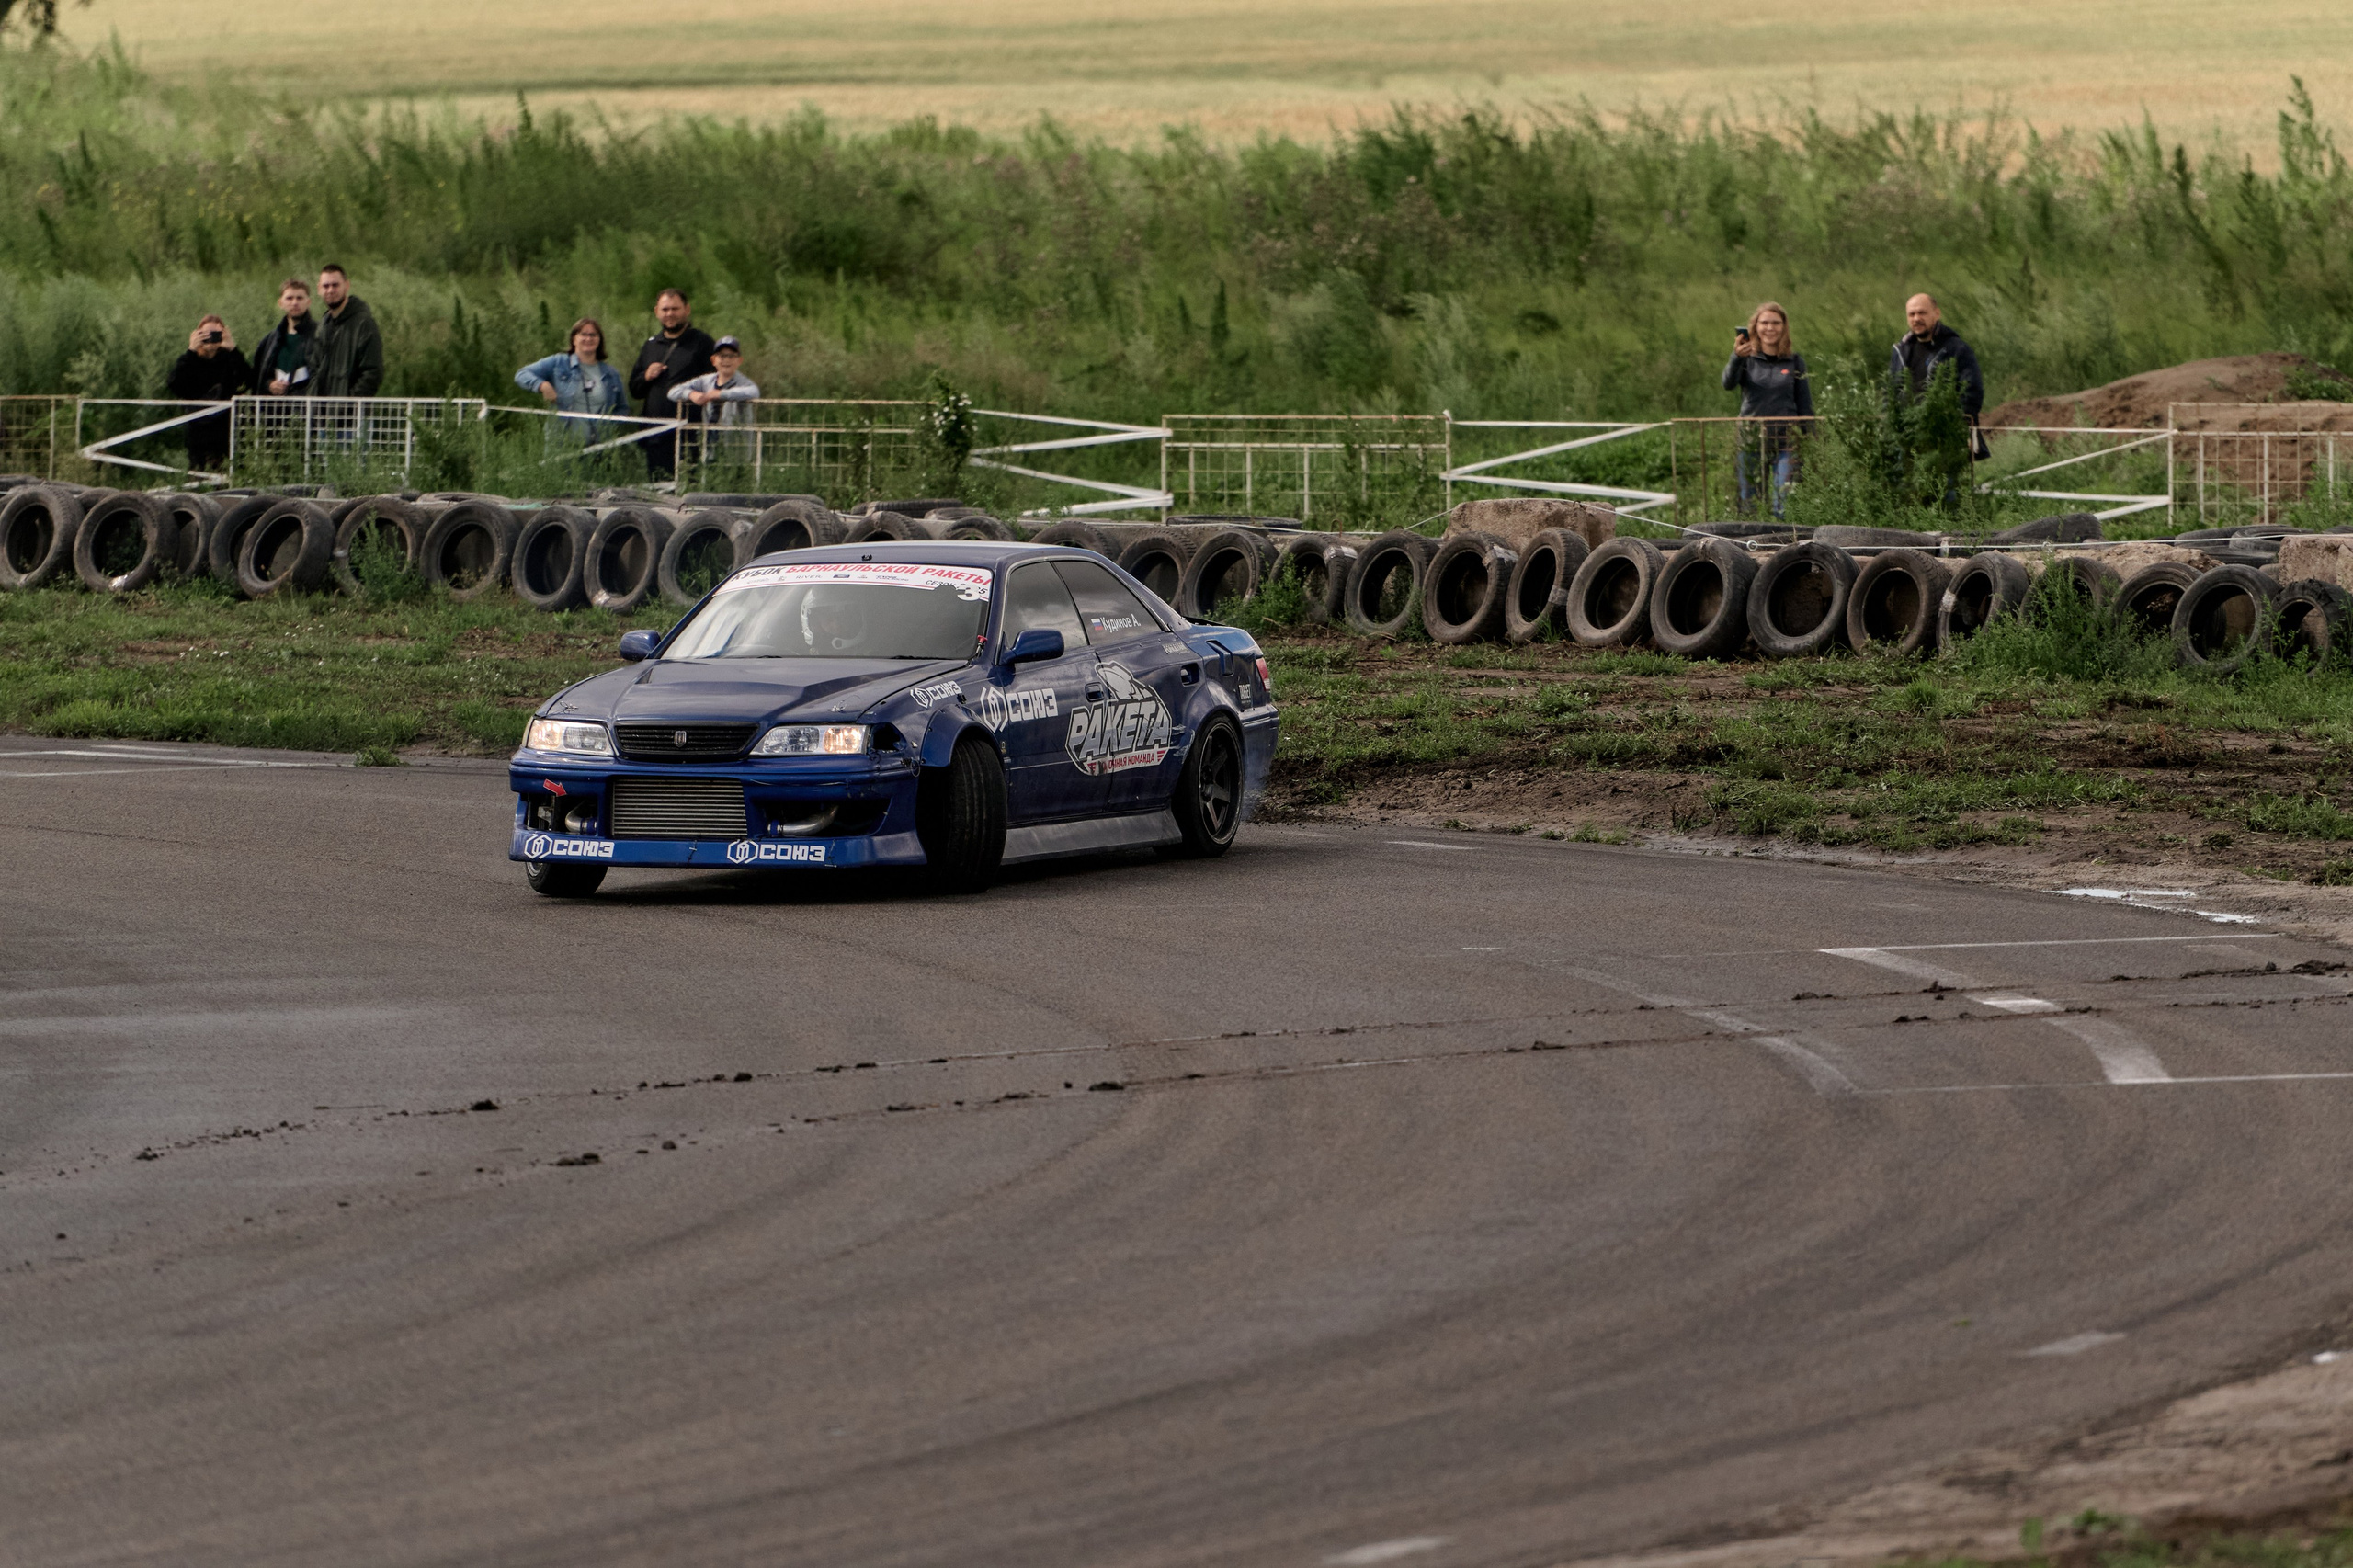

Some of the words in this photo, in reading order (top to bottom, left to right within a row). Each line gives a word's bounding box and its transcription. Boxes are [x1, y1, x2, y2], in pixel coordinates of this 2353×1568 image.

[731, 567, 786, 582] КУБОК
[786, 564, 920, 574] БАРНАУЛЬСКОЙ
[920, 568, 991, 585] РАКЕТЫ
[1100, 617, 1132, 633] Кудинов
[926, 680, 962, 701] СОЮЗ
[1006, 687, 1059, 722] СОЮЗ
[1068, 699, 1170, 761] РАКЕТА
[1127, 752, 1155, 767] КОМАНДА
[552, 839, 615, 858] СОЮЗ
[759, 843, 826, 862] СОЮЗ
